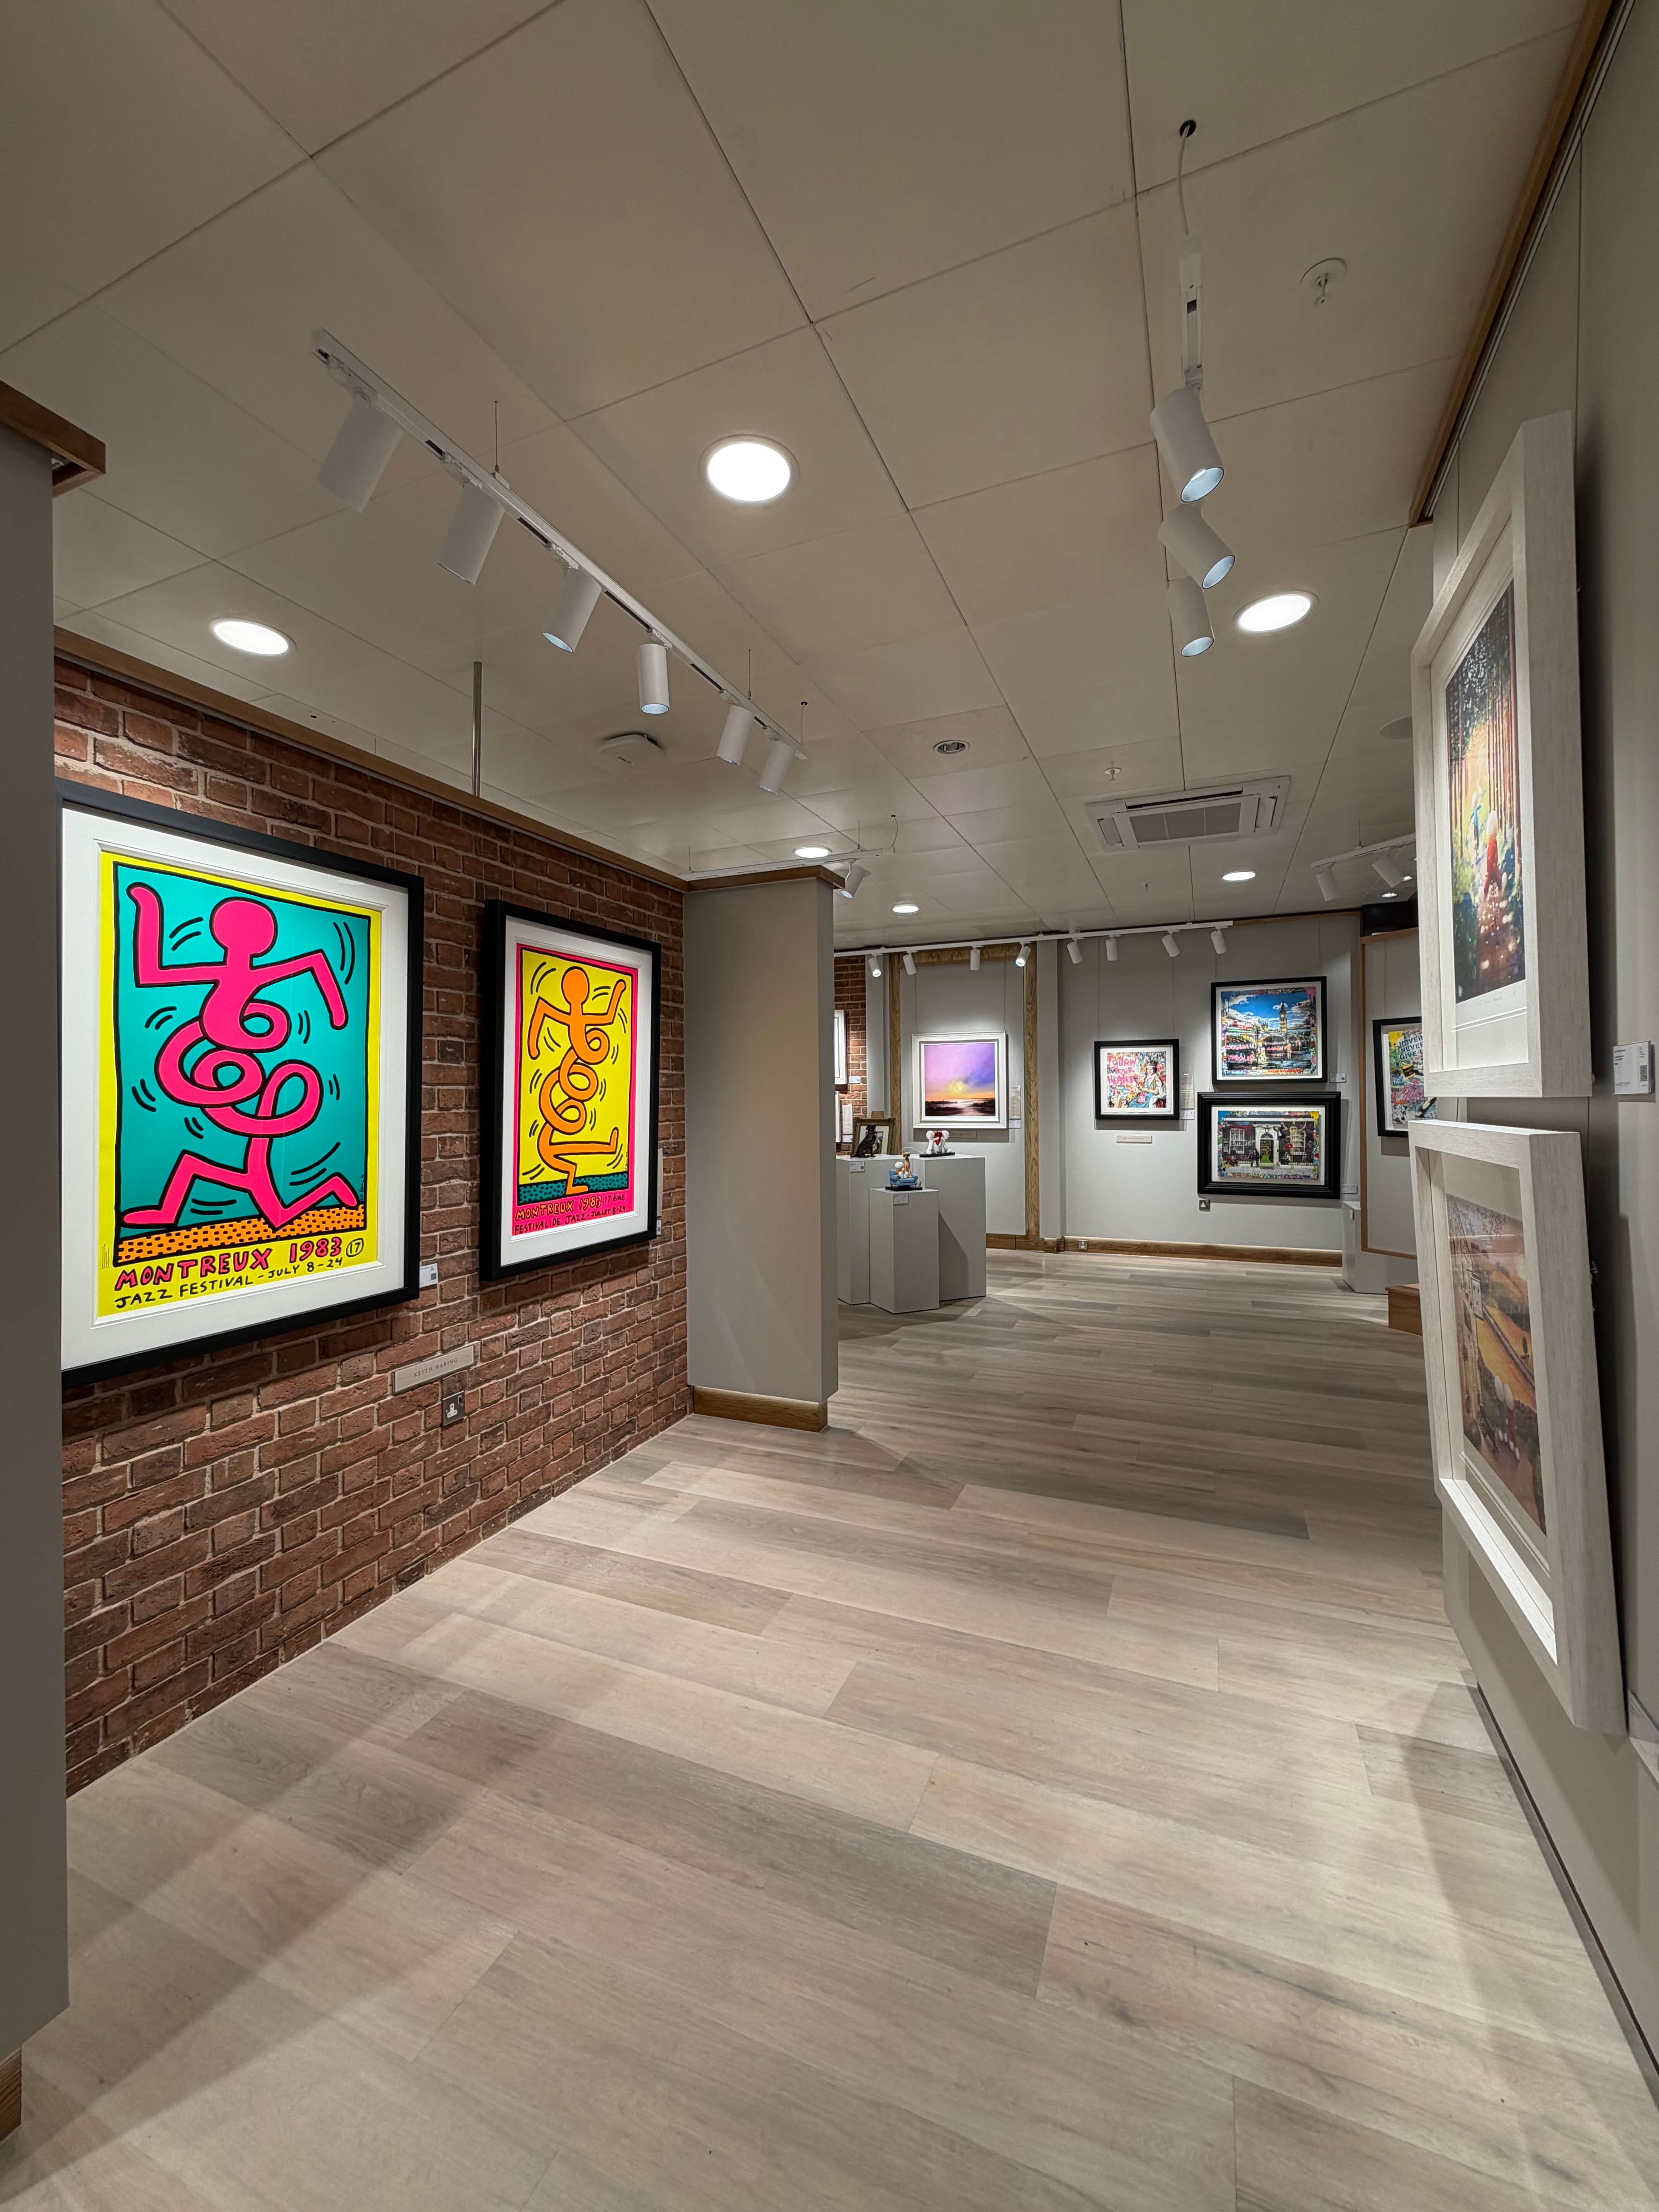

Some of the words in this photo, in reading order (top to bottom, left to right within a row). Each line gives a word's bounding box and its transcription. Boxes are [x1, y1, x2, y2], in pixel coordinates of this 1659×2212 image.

[1400, 1051, 1417, 1060] GIVE
[515, 1200, 574, 1221] MONTREUX
[579, 1195, 602, 1211] 1983
[605, 1195, 611, 1203] 17
[515, 1220, 549, 1235] FESTIVAL
[553, 1217, 561, 1226] DE
[565, 1213, 586, 1224] JAZZ
[114, 1248, 273, 1291] MONTREUX
[289, 1236, 342, 1264] 1983
[114, 1289, 173, 1309] JAZZ
[180, 1275, 254, 1297] FESTIVAL
[268, 1264, 300, 1278] JULY
[414, 1366, 433, 1377] KEITH
[435, 1357, 458, 1370] HARING
